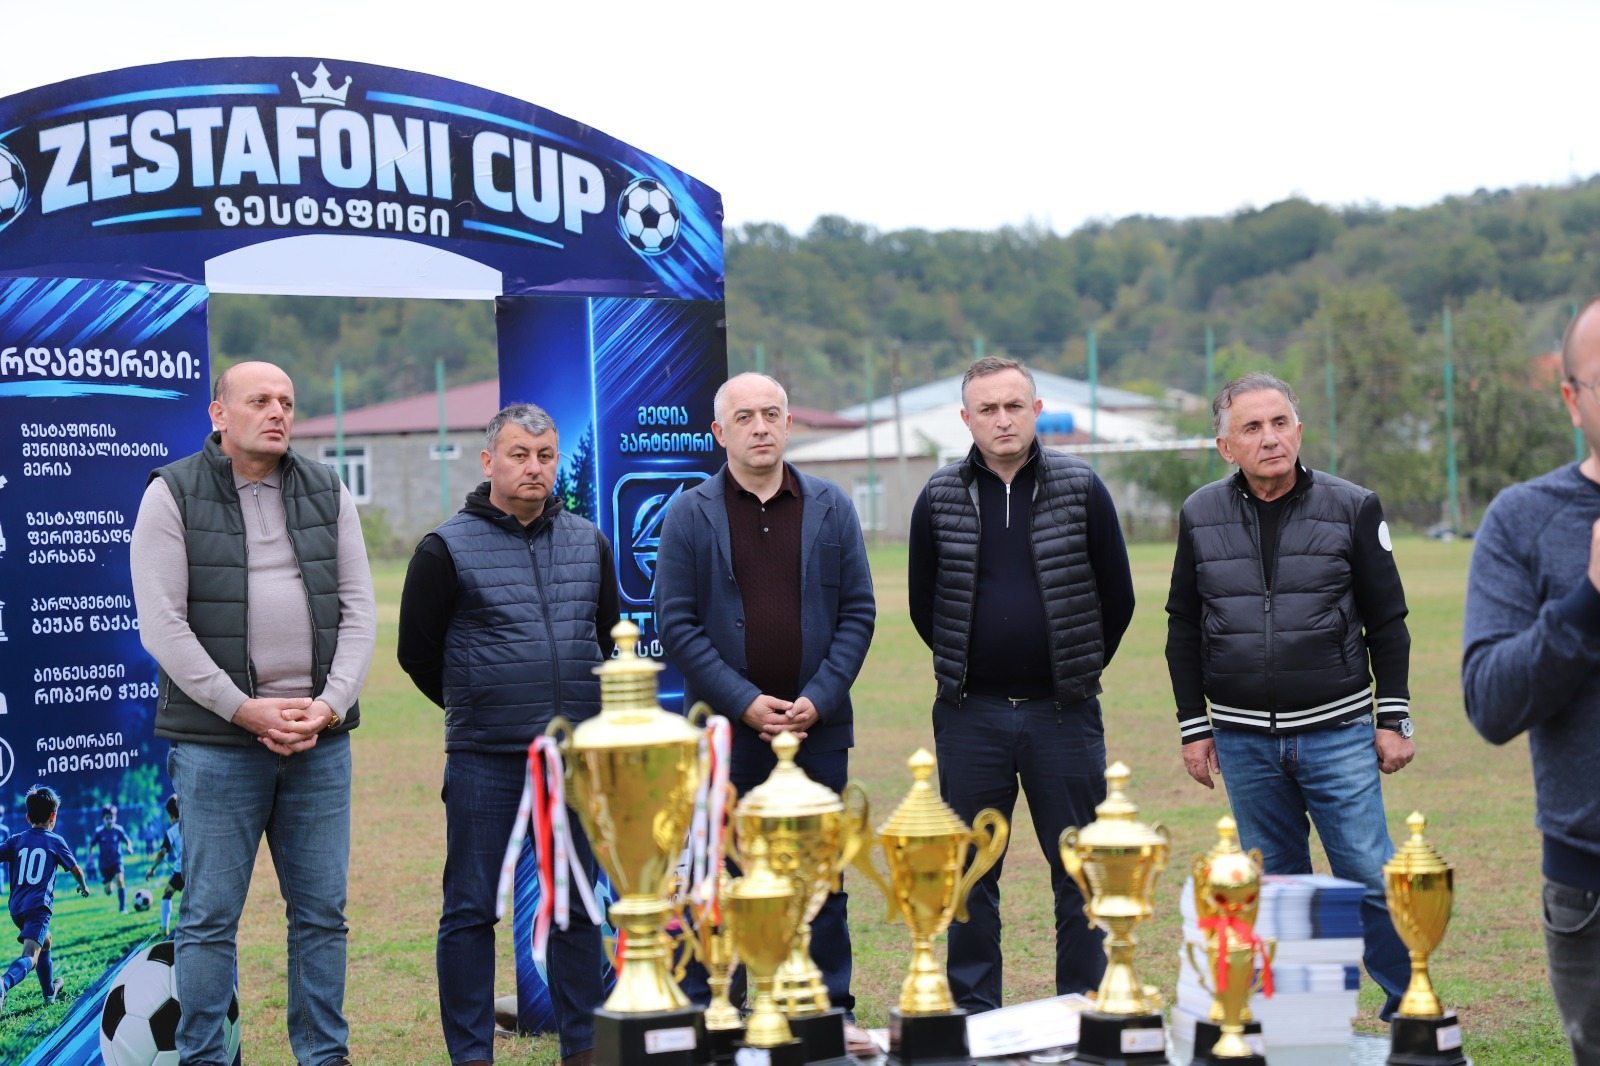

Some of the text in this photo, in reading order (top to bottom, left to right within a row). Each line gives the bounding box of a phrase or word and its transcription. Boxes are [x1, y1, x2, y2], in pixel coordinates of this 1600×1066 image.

[39, 105, 607, 233] ZESTAFONI CUP
[214, 193, 452, 239] ზესტაფონი
[637, 405, 689, 426] მედია
[20, 423, 117, 438] ზესტაფონის
[22, 442, 169, 457] მუნიციპალიტეტის
[619, 432, 714, 453] პარტნიორი
[23, 461, 72, 477] მერია
[26, 510, 124, 526] ზესტაფონის
[28, 548, 96, 565] ქარხანა
[30, 594, 131, 612] პარლამენტის
[31, 616, 84, 635] ბეჟან
[33, 663, 125, 683] ბიზნესმენი
[34, 687, 112, 705] რობერტ
[36, 732, 123, 752] რესტორანი
[18, 847, 47, 886] 10
